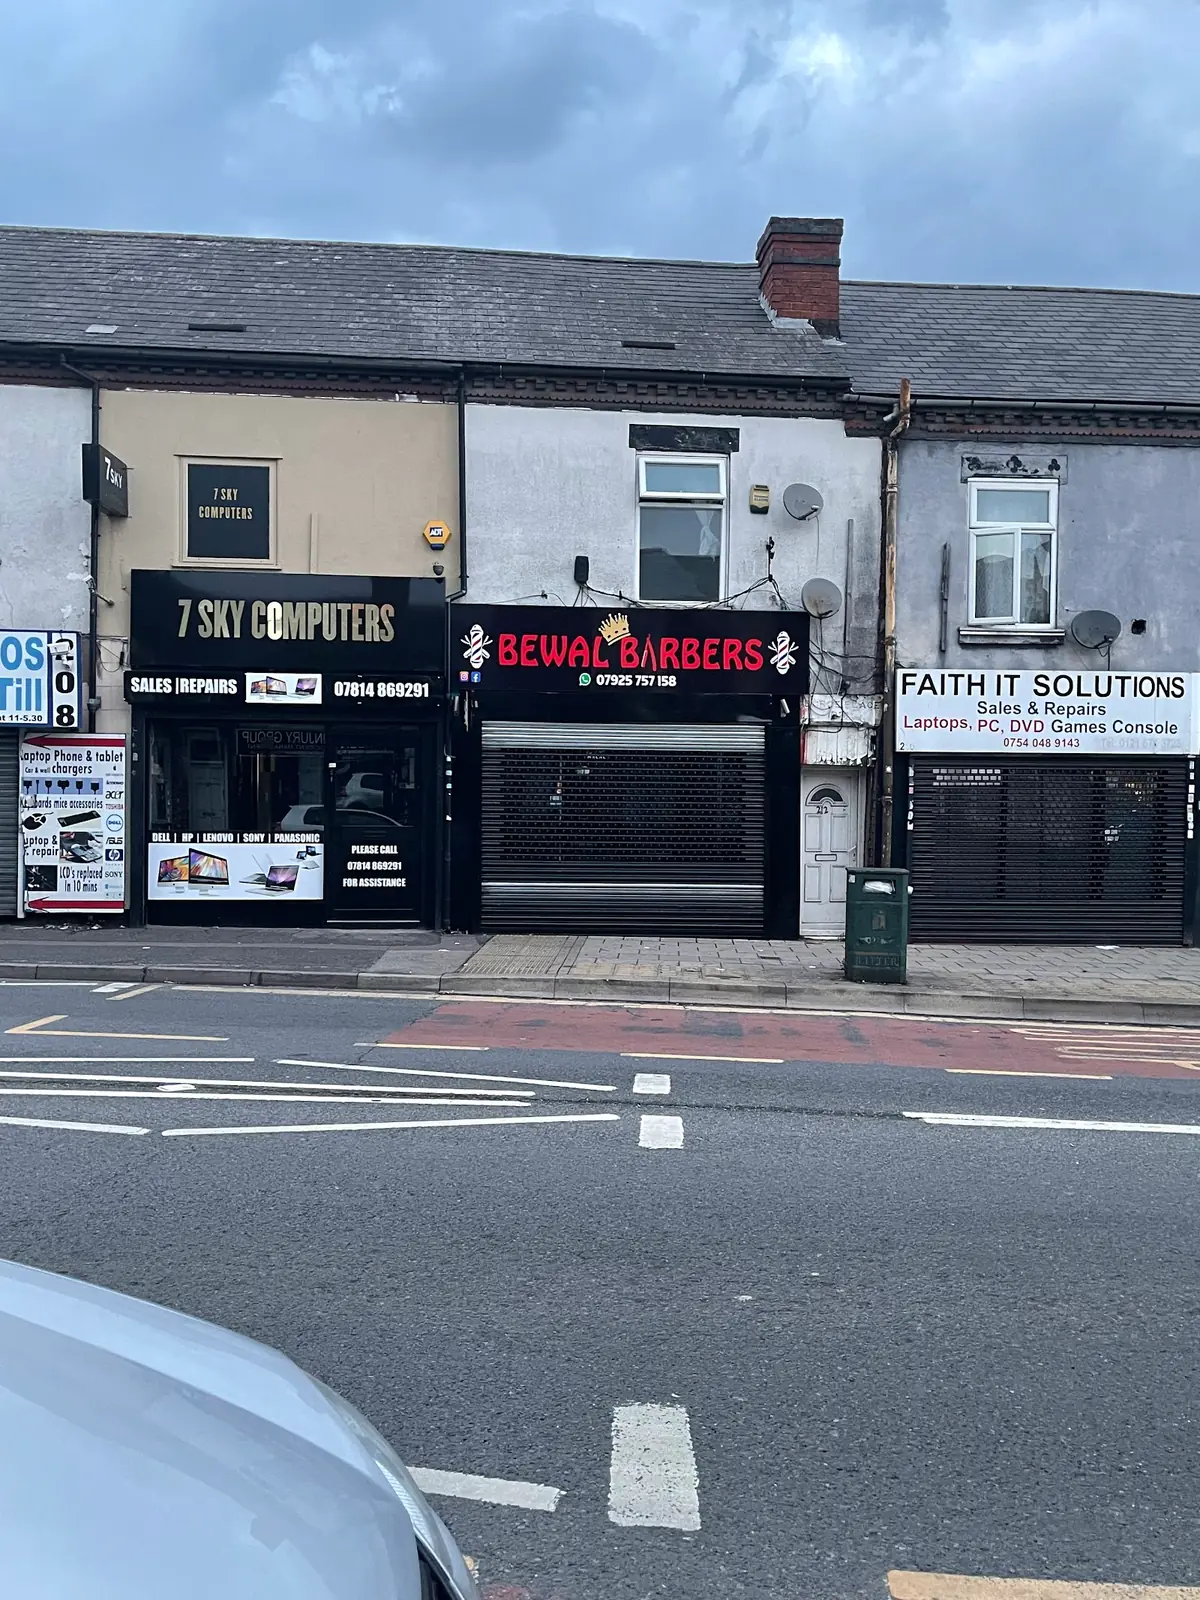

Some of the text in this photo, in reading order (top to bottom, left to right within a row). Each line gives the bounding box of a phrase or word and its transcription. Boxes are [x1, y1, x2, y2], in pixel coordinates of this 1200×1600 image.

[214, 488, 238, 501] 7 SKY
[199, 505, 253, 520] COMPUTERS
[430, 528, 443, 536] ADT
[178, 599, 395, 642] 7 SKY COMPUTERS
[498, 633, 764, 672] BEWAL BARBERS
[130, 677, 173, 694] SALES
[596, 674, 677, 687] 07925 757 158
[901, 673, 1186, 698] FAITH IT SOLUTIONS
[333, 681, 430, 698] 07814 869291
[977, 700, 1107, 718] Sales & Repairs
[9, 714, 43, 722] 11-5.30
[904, 715, 1178, 735] Laptops, PC, DVD Games Console
[1003, 738, 1080, 748] 0754 048 9143
[54, 750, 83, 762] Phone
[86, 750, 93, 762] &
[96, 750, 123, 762] tablet
[52, 762, 93, 776] chargers
[105, 790, 124, 800] acer
[54, 797, 67, 809] mice
[69, 797, 103, 809] accessories
[24, 834, 58, 848] aptop &
[152, 833, 320, 843] DELL HP LENOVO SONY PANASONIC
[32, 845, 60, 858] repair
[351, 845, 399, 854] PLEASE CALL
[347, 861, 402, 870] 07814 869291
[76, 866, 103, 882] replaced
[73, 880, 81, 892] 10
[82, 880, 98, 892] mins
[342, 877, 407, 887] FOR ASSISTANCE
